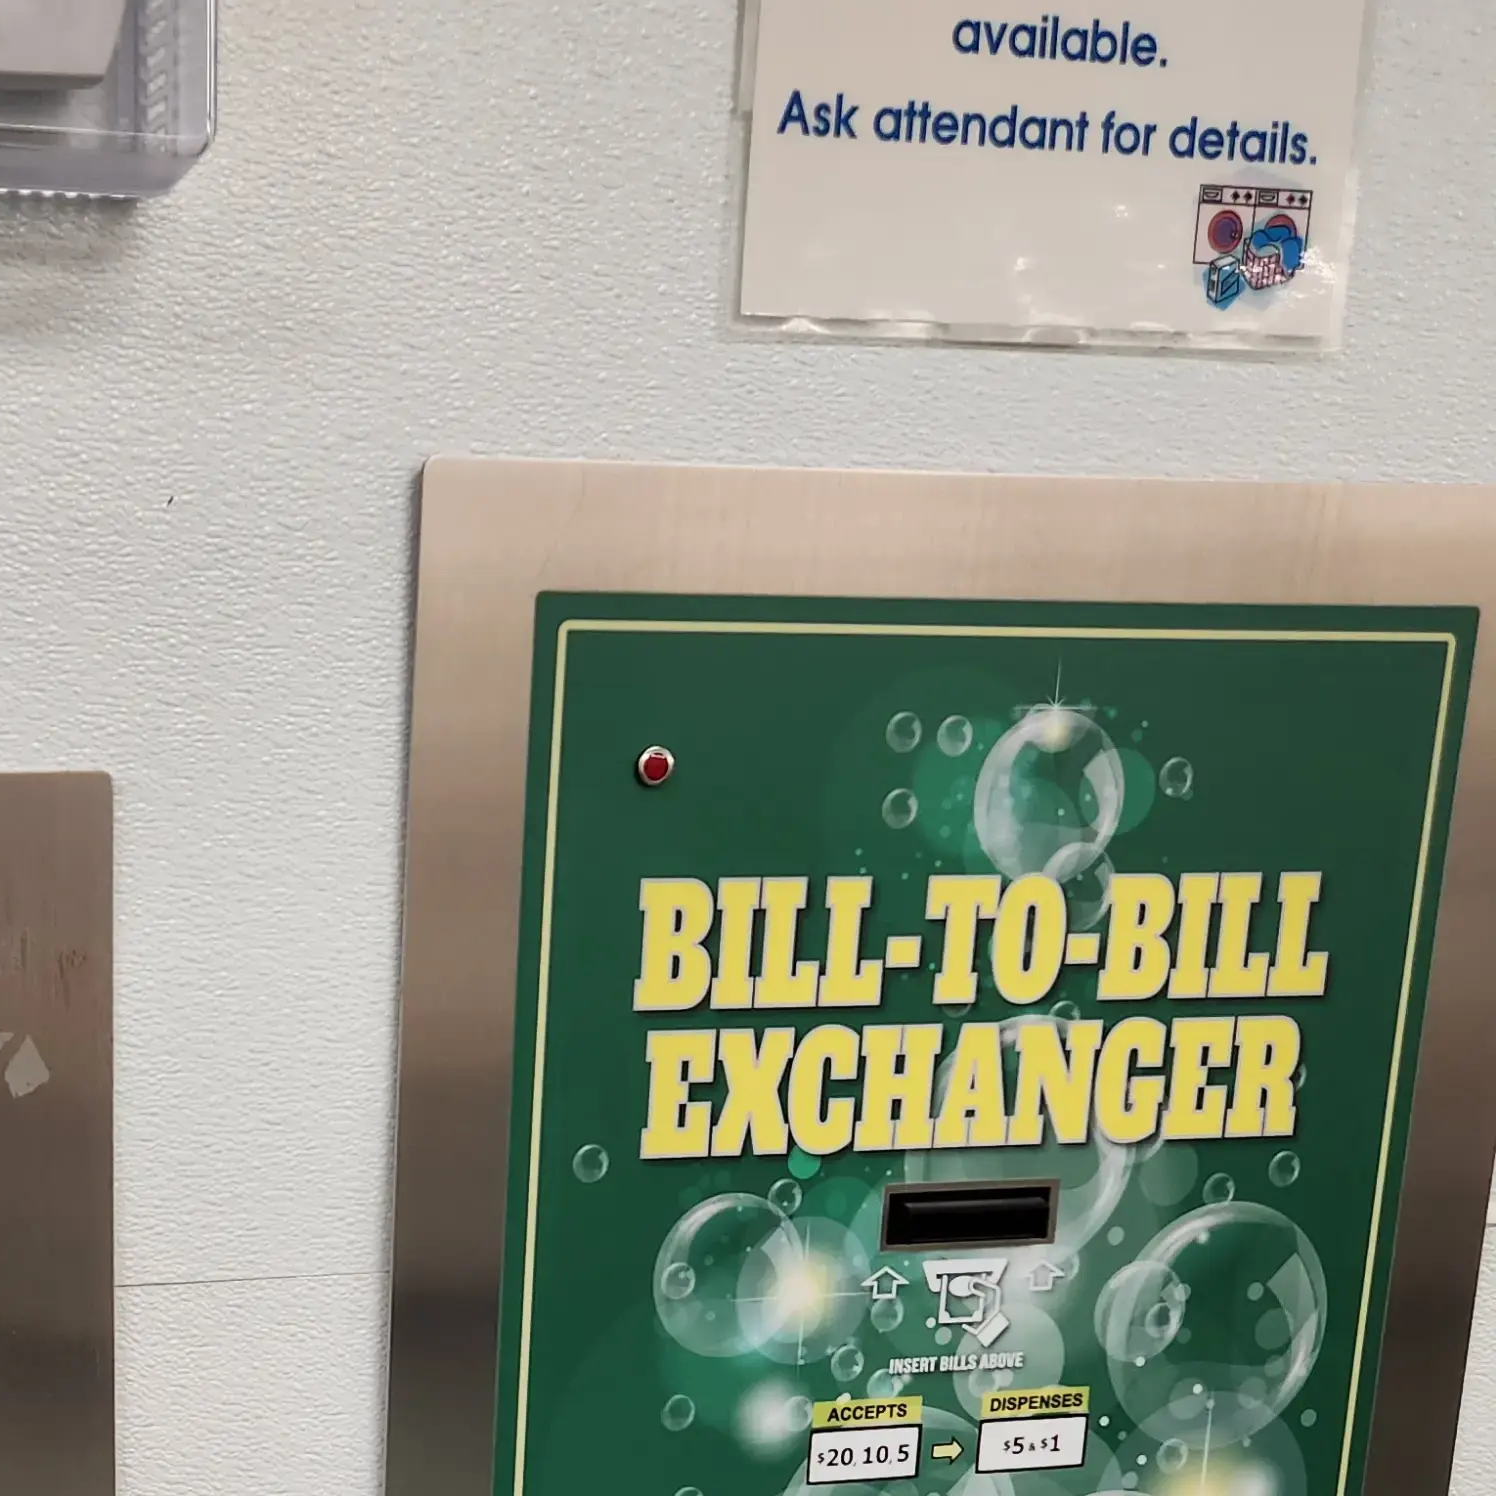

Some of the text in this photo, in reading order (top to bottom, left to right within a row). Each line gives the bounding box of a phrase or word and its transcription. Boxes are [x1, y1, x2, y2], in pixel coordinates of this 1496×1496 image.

[952, 15, 1168, 68] available.
[777, 90, 1318, 165] Ask attendant for details.
[632, 871, 1329, 1012] BILL-TO-BILL
[639, 1013, 1302, 1160] EXCHANGER
[889, 1352, 1024, 1375] INSERT BILLS ABOVE
[827, 1403, 907, 1423] ACCEPTS
[990, 1393, 1083, 1412] DISPENSES
[897, 1444, 910, 1463] 5
[1003, 1436, 1025, 1455] $5
[1040, 1434, 1061, 1452] $1
